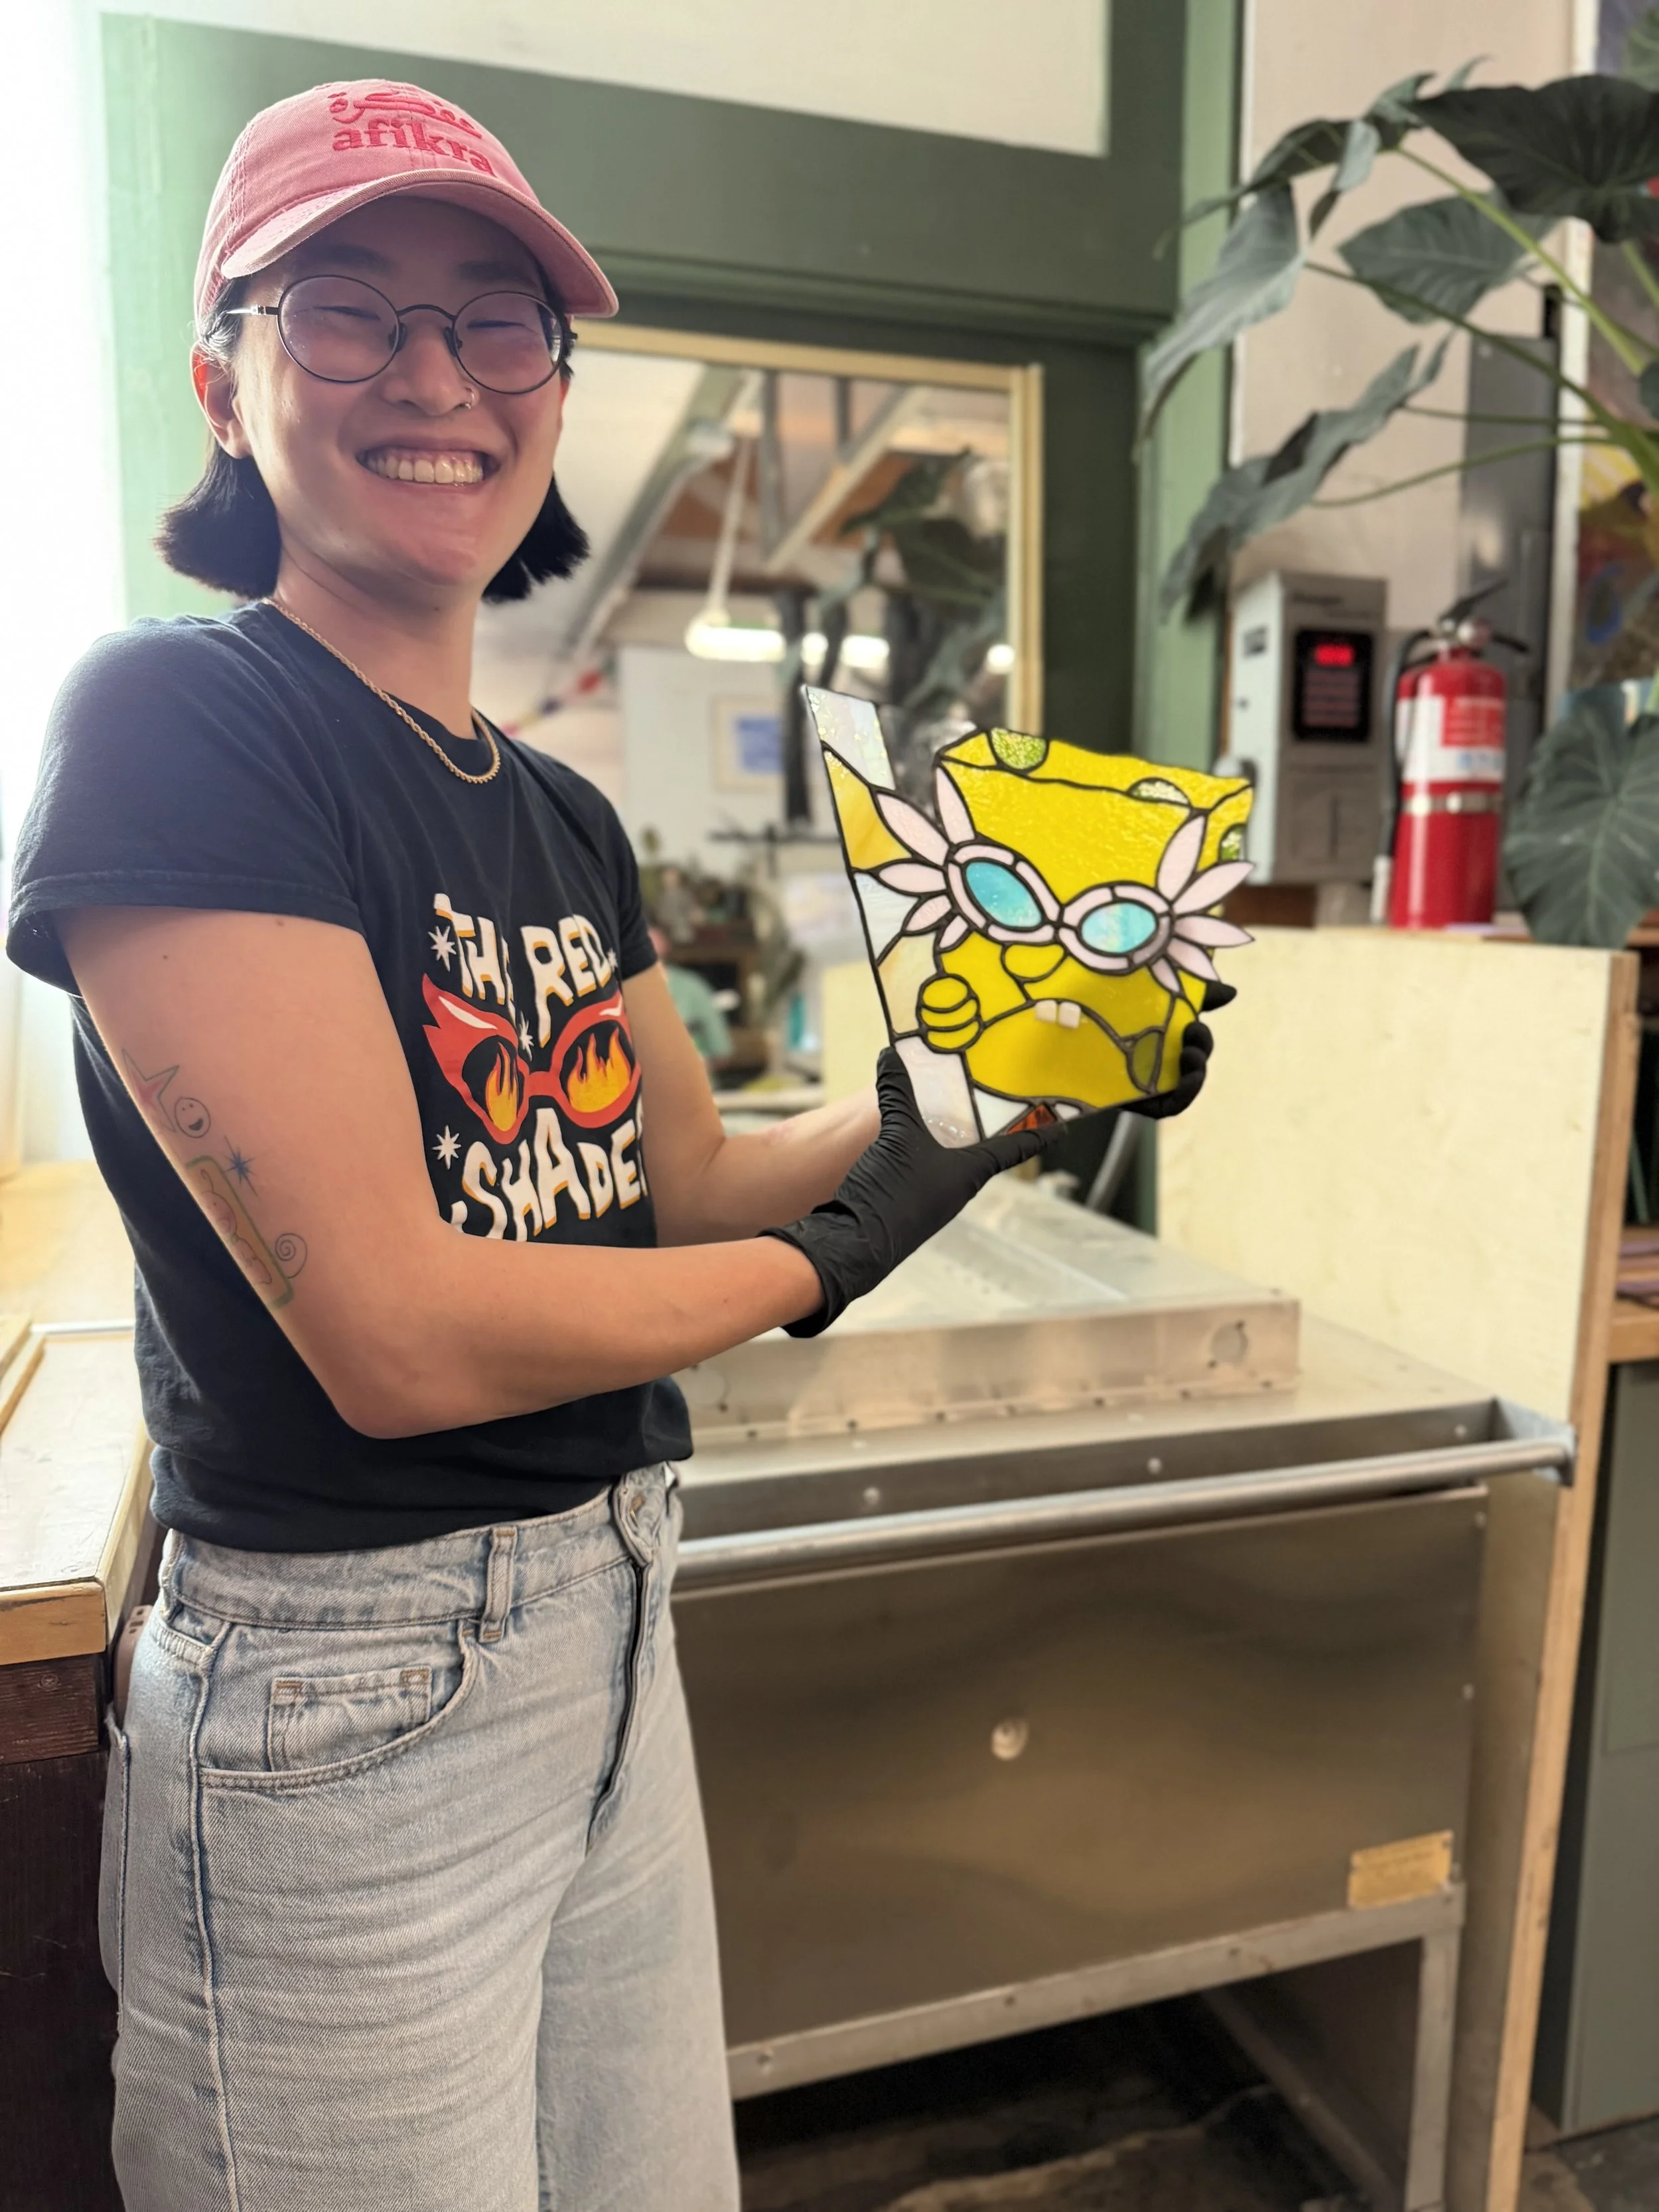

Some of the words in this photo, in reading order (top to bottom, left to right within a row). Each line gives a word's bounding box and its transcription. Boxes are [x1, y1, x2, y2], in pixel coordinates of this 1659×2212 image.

[332, 117, 496, 177] afikra
[434, 893, 516, 1025] TH
[520, 914, 611, 1049] RED
